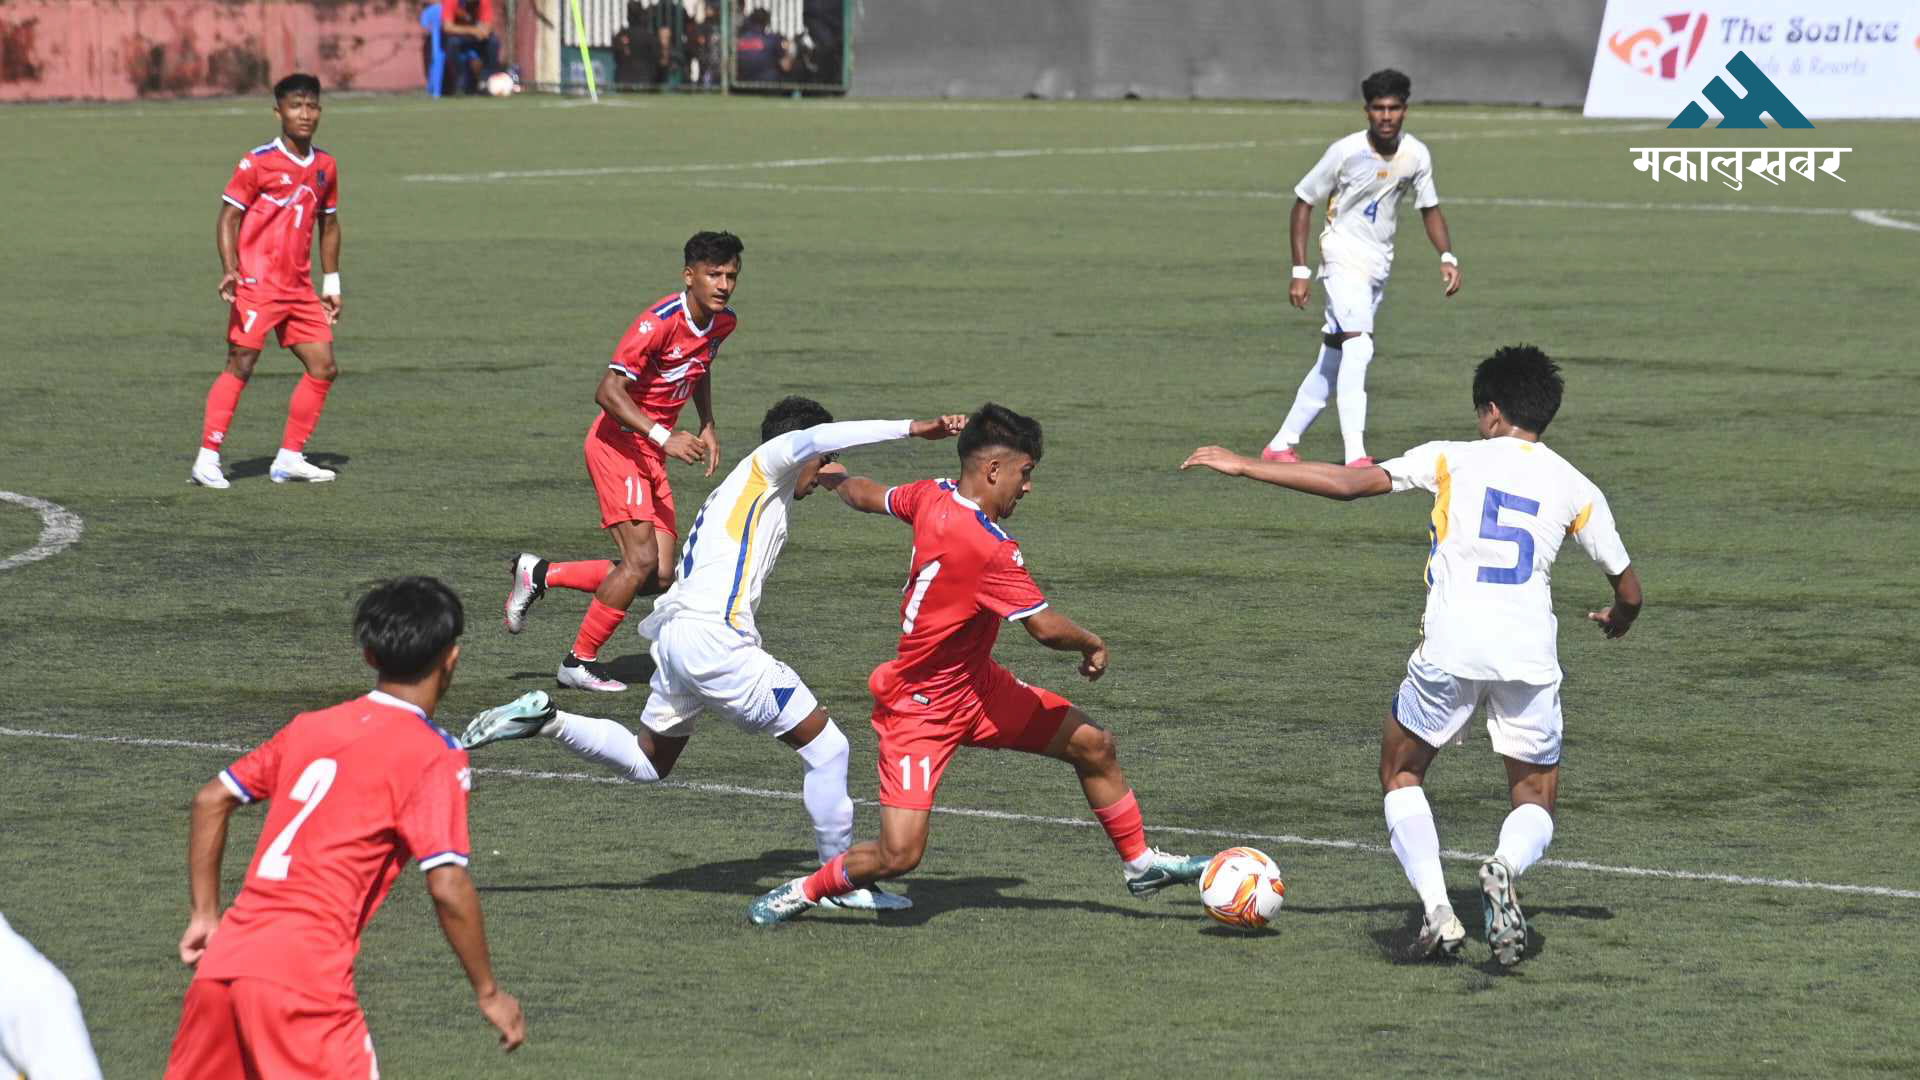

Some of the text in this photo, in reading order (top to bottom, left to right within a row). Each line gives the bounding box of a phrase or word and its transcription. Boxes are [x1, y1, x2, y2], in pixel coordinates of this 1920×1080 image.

[1721, 16, 1899, 44] The Soaltee
[1363, 201, 1380, 224] 4
[244, 309, 257, 333] 7
[1476, 486, 1540, 585] 5
[899, 754, 931, 792] 11
[256, 757, 337, 880] 2
